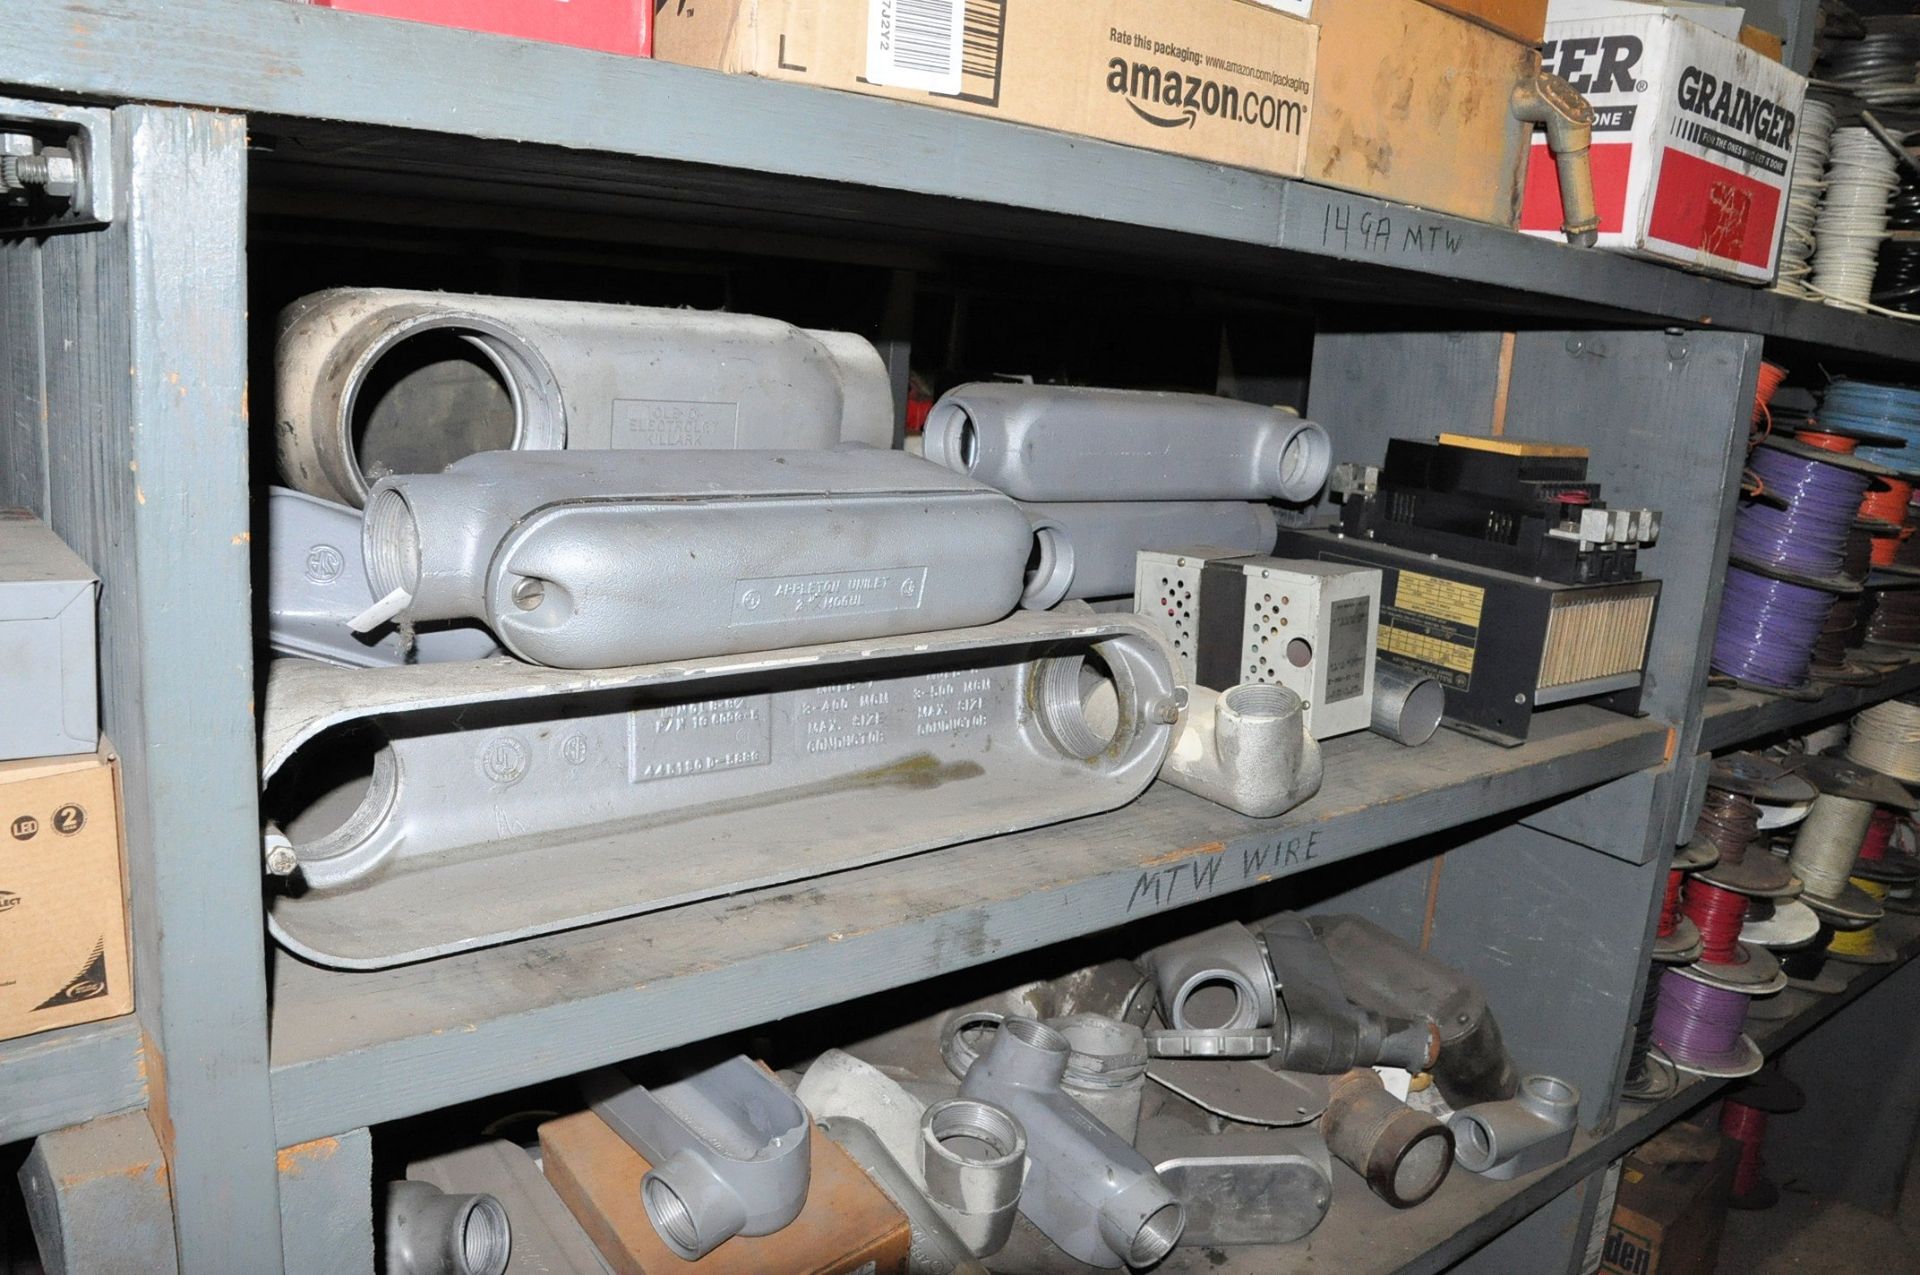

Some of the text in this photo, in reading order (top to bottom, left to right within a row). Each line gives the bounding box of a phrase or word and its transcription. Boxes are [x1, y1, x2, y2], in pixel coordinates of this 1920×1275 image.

[1110, 27, 1310, 95] Rate this packaging: www.amazon.com/packaging
[1106, 56, 1303, 136] amazon.com
[1678, 65, 1796, 151] GRAINGER
[1715, 136, 1729, 150] THE
[1727, 141, 1742, 157] ONES
[1770, 158, 1784, 173] DONE
[1322, 203, 1462, 254] 14 GA MTW
[13, 820, 38, 836] LED
[61, 807, 77, 826] 2
[1127, 830, 1324, 913] MTW WIRE
